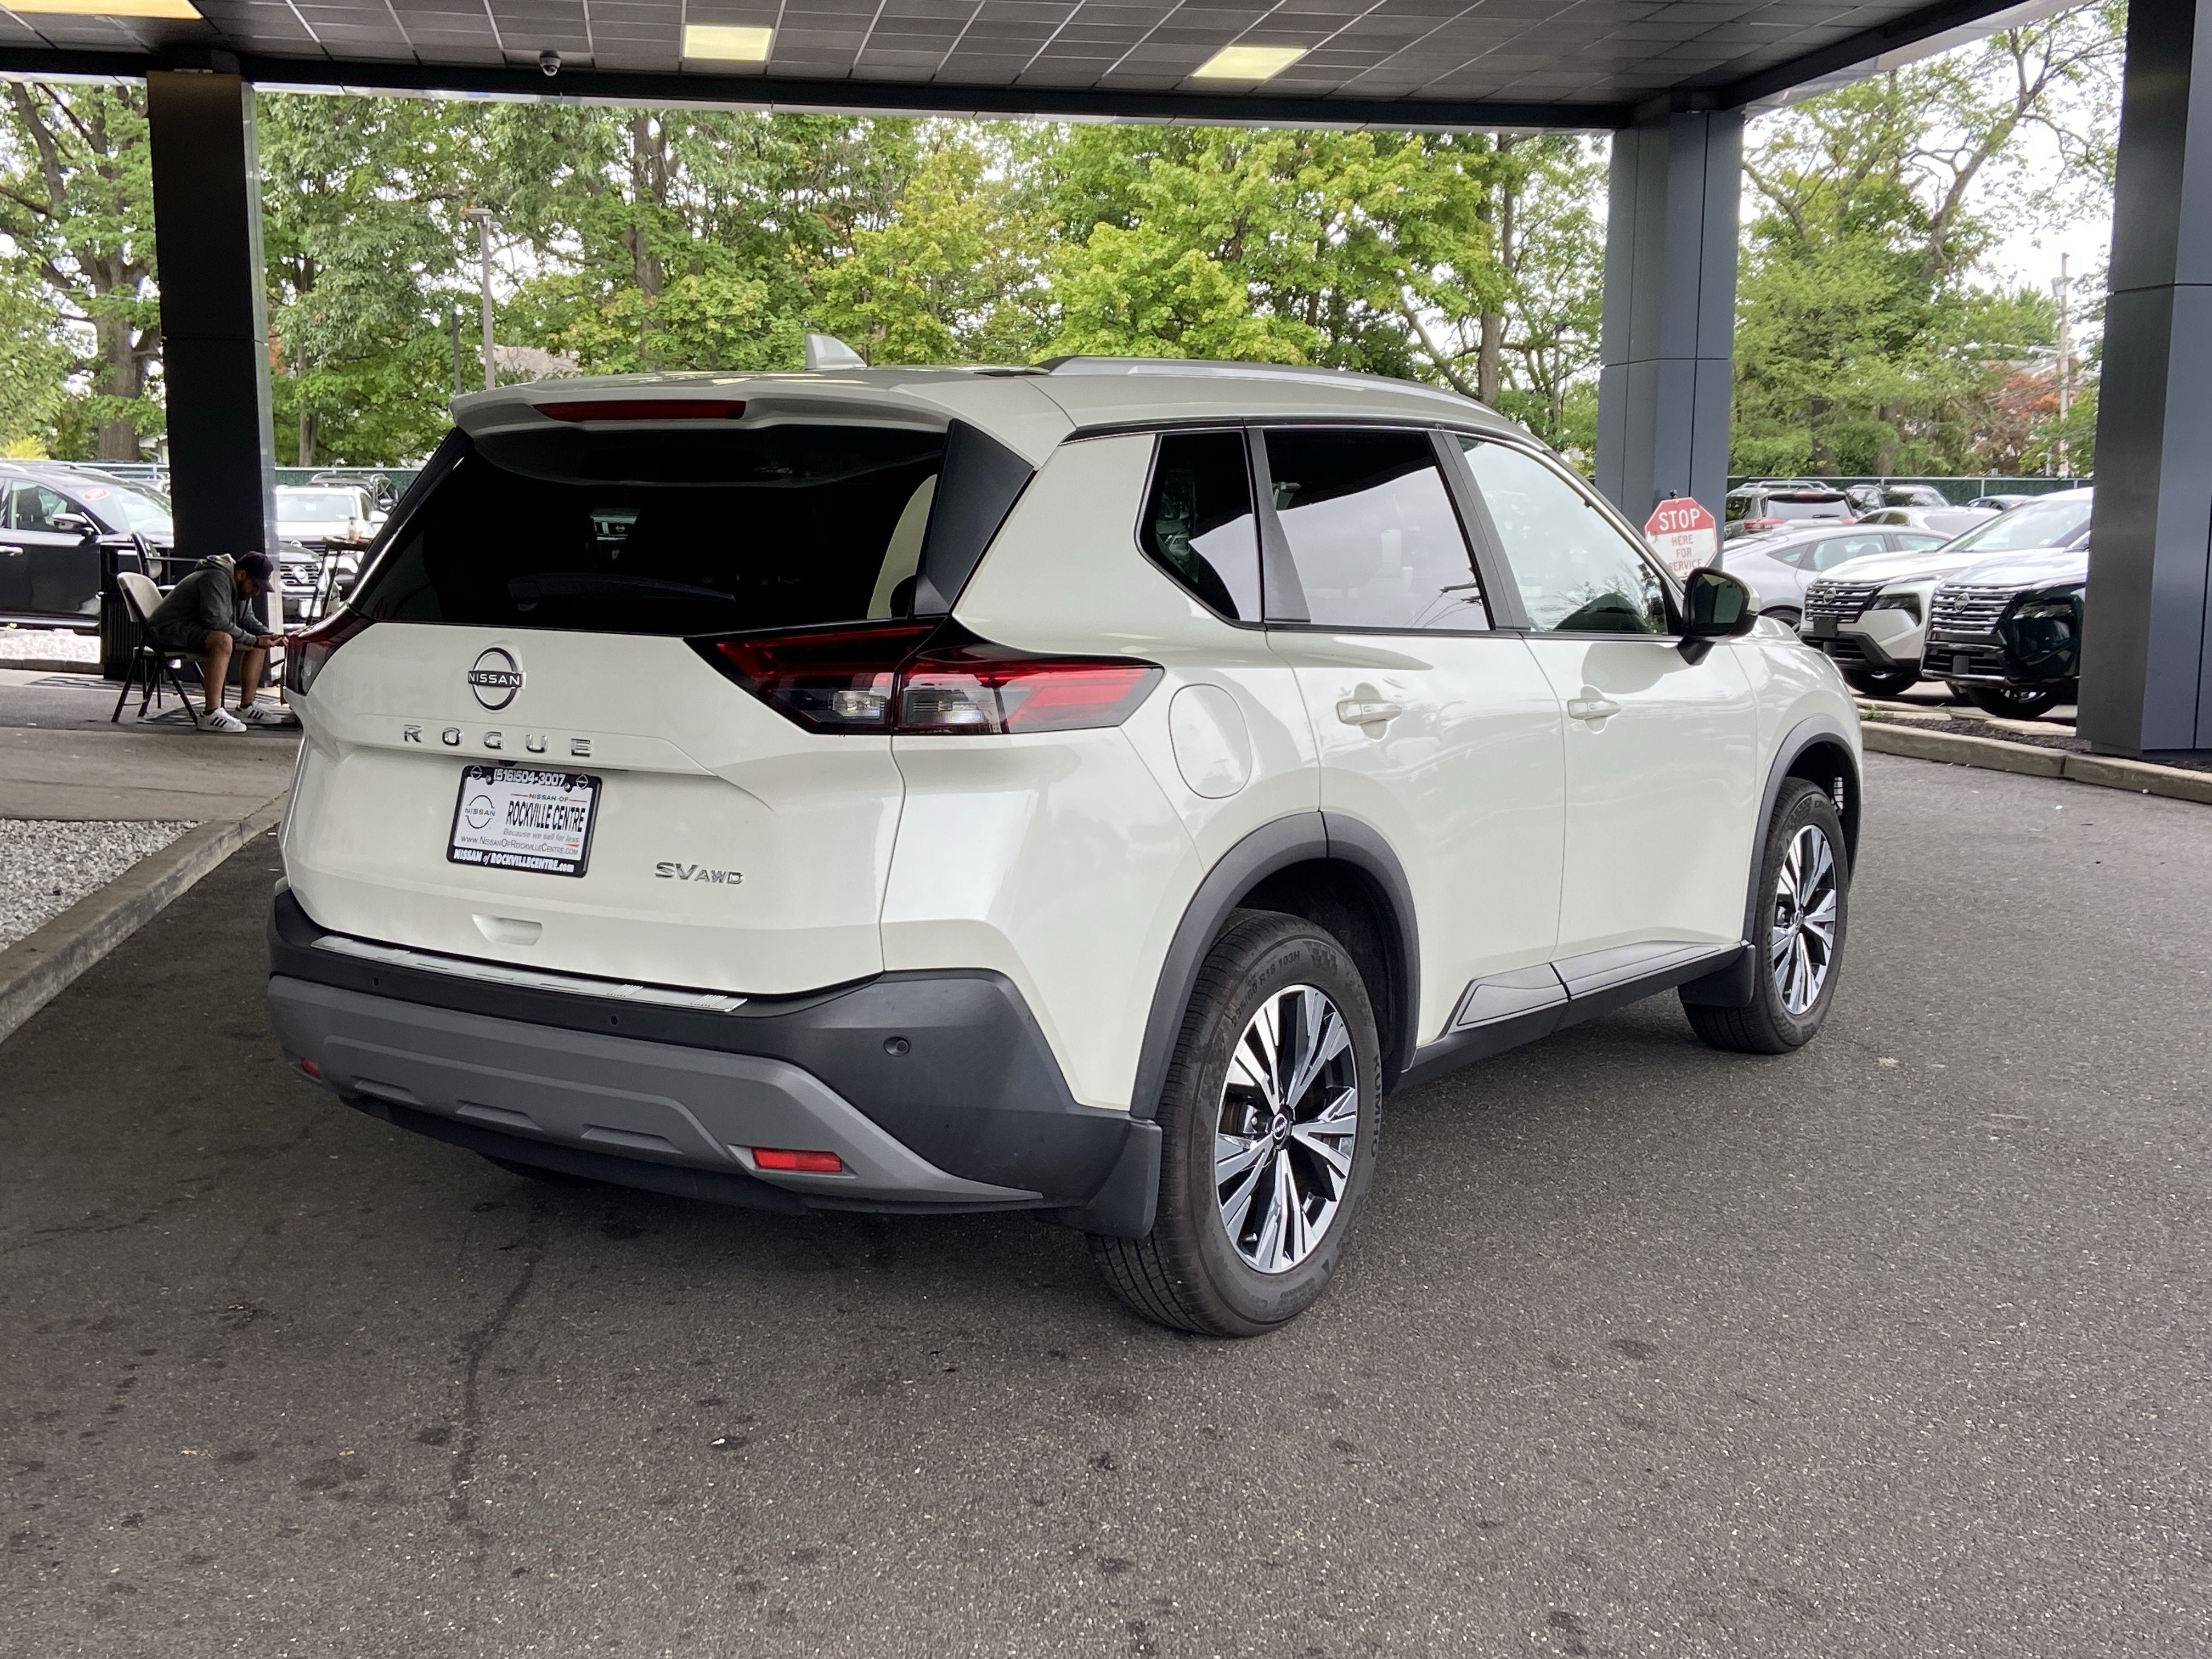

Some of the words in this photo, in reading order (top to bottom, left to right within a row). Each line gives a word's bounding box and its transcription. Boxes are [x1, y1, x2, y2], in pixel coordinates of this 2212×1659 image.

[1659, 508, 1701, 531] STOP
[1672, 534, 1694, 546] HERE
[1676, 548, 1692, 559] FOR
[1668, 558, 1702, 572] SERVICE
[468, 672, 521, 686] NISSAN
[404, 724, 592, 758] ROGUE
[465, 808, 496, 816] NISSAN
[505, 800, 553, 829] ROCKVILLE
[552, 804, 586, 832] CENTRE
[503, 828, 531, 837] Because
[555, 834, 566, 842] for
[453, 848, 483, 862] NISSAN
[483, 852, 492, 865] of
[490, 853, 574, 873] ROCKVILLECENTRE.com
[1278, 950, 1300, 968] 103H
[1371, 1053, 1381, 1158] KUMHO
